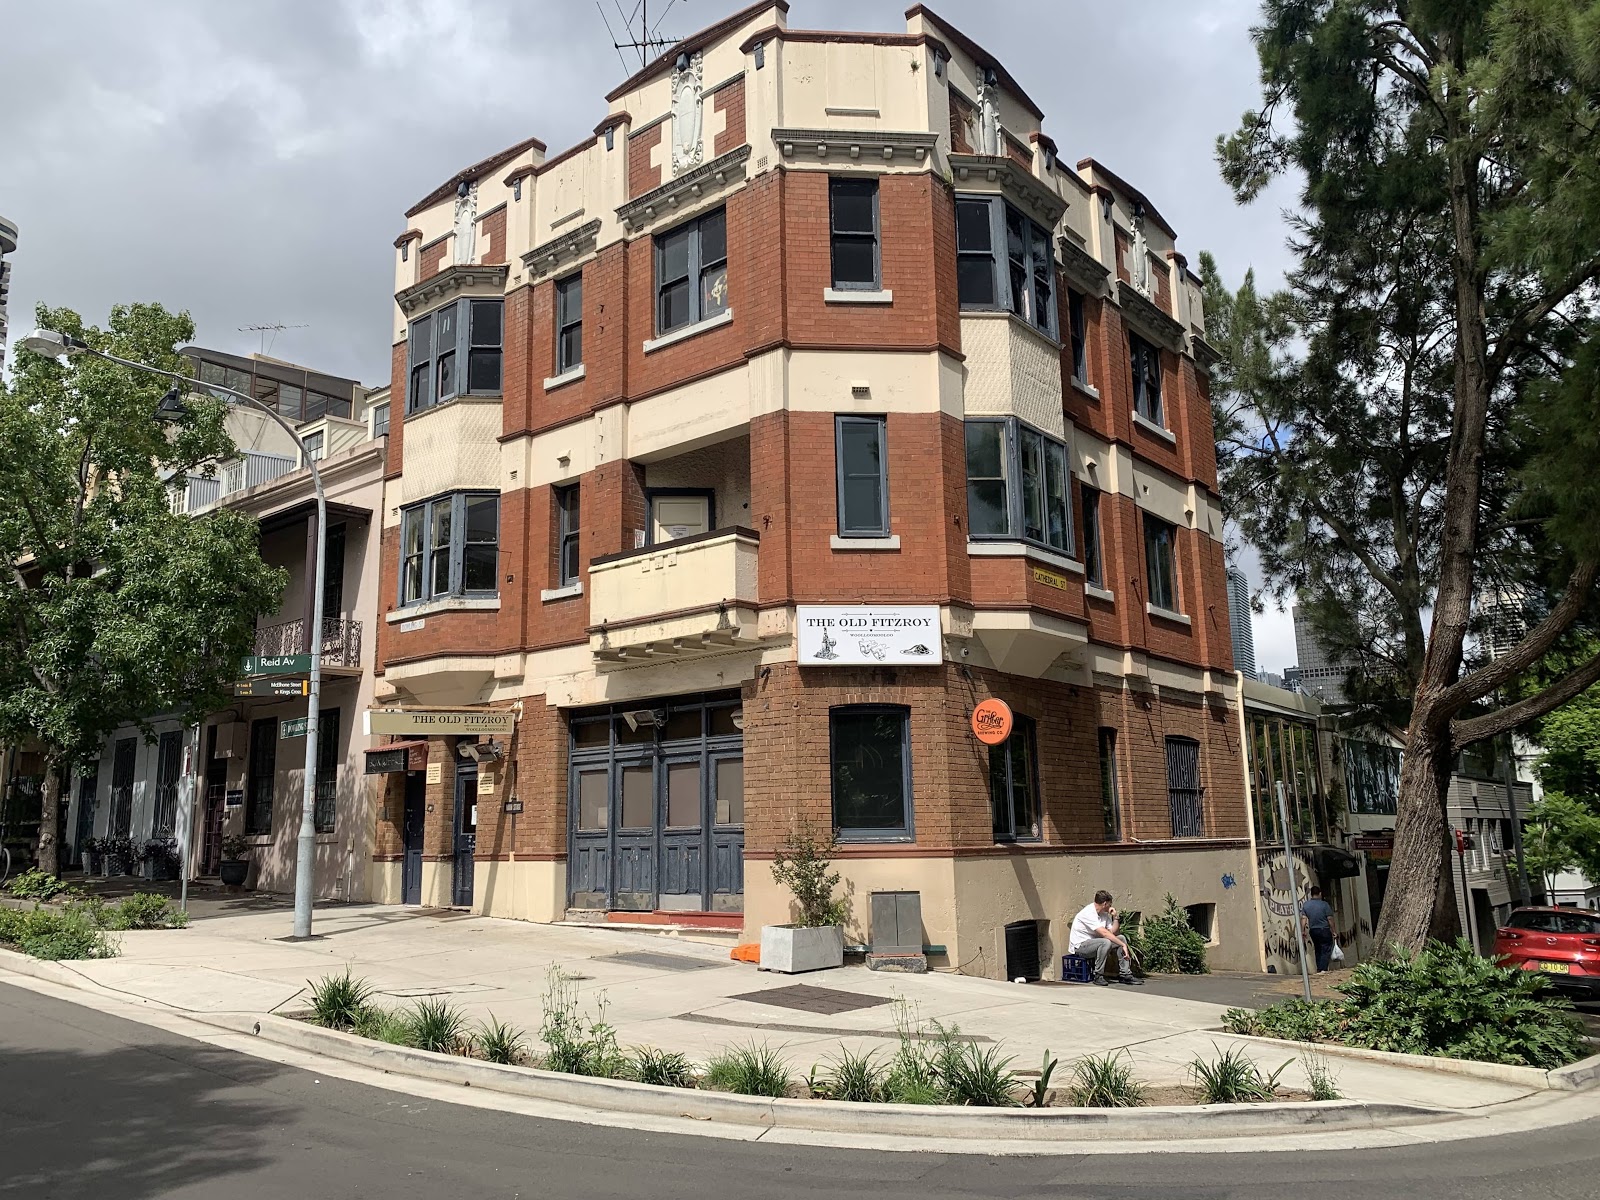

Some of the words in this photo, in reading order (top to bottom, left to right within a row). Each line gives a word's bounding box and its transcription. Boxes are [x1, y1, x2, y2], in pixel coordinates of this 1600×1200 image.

[1035, 572, 1059, 587] CATHEDRAL
[806, 618, 836, 627] THE
[839, 618, 868, 627] OLD
[872, 618, 931, 627] FITZROY
[260, 657, 281, 667] Reid
[282, 657, 295, 666] Av
[412, 715, 436, 724] THE
[438, 715, 461, 724] OLD
[464, 716, 509, 724] FITZROY
